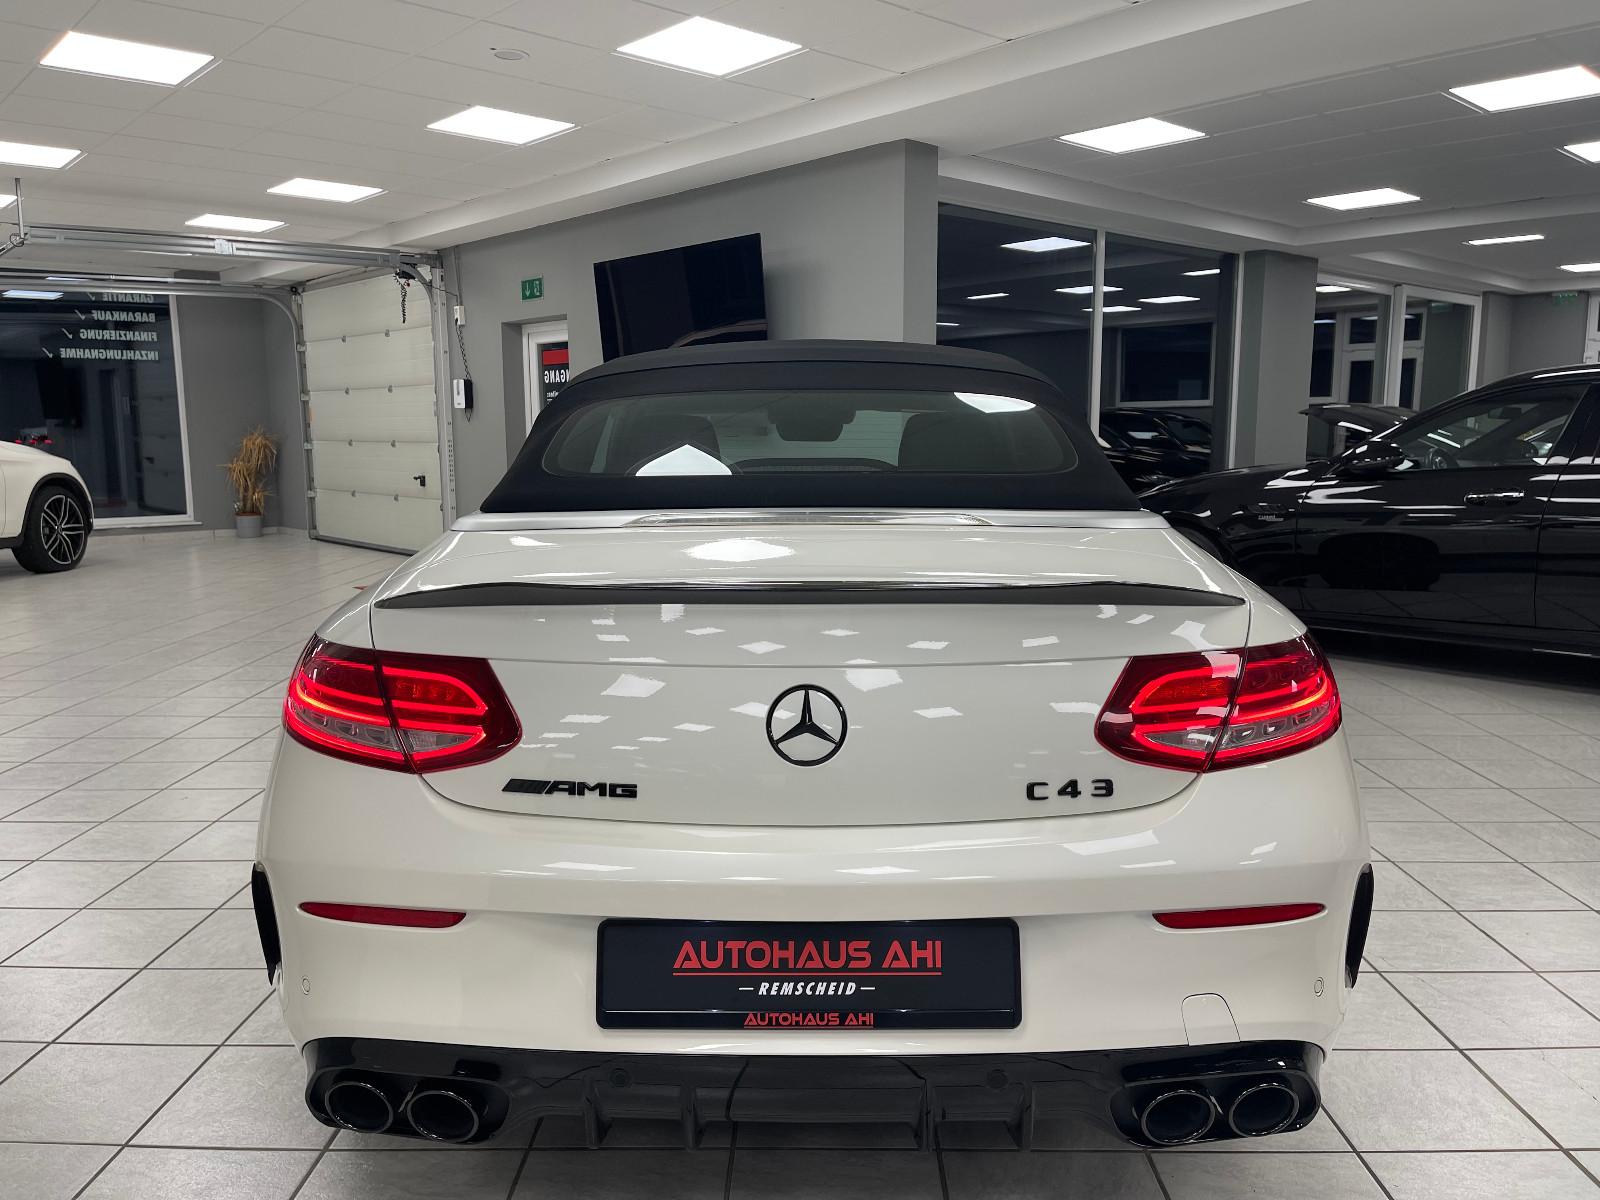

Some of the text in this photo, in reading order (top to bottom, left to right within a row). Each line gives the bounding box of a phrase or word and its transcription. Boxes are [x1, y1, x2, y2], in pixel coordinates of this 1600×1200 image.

[544, 780, 638, 799] AMG
[672, 940, 942, 969] AUTOHAUS AHI
[757, 982, 857, 996] REMSCHEID
[743, 1012, 874, 1026] AUTOHAUS AHI
